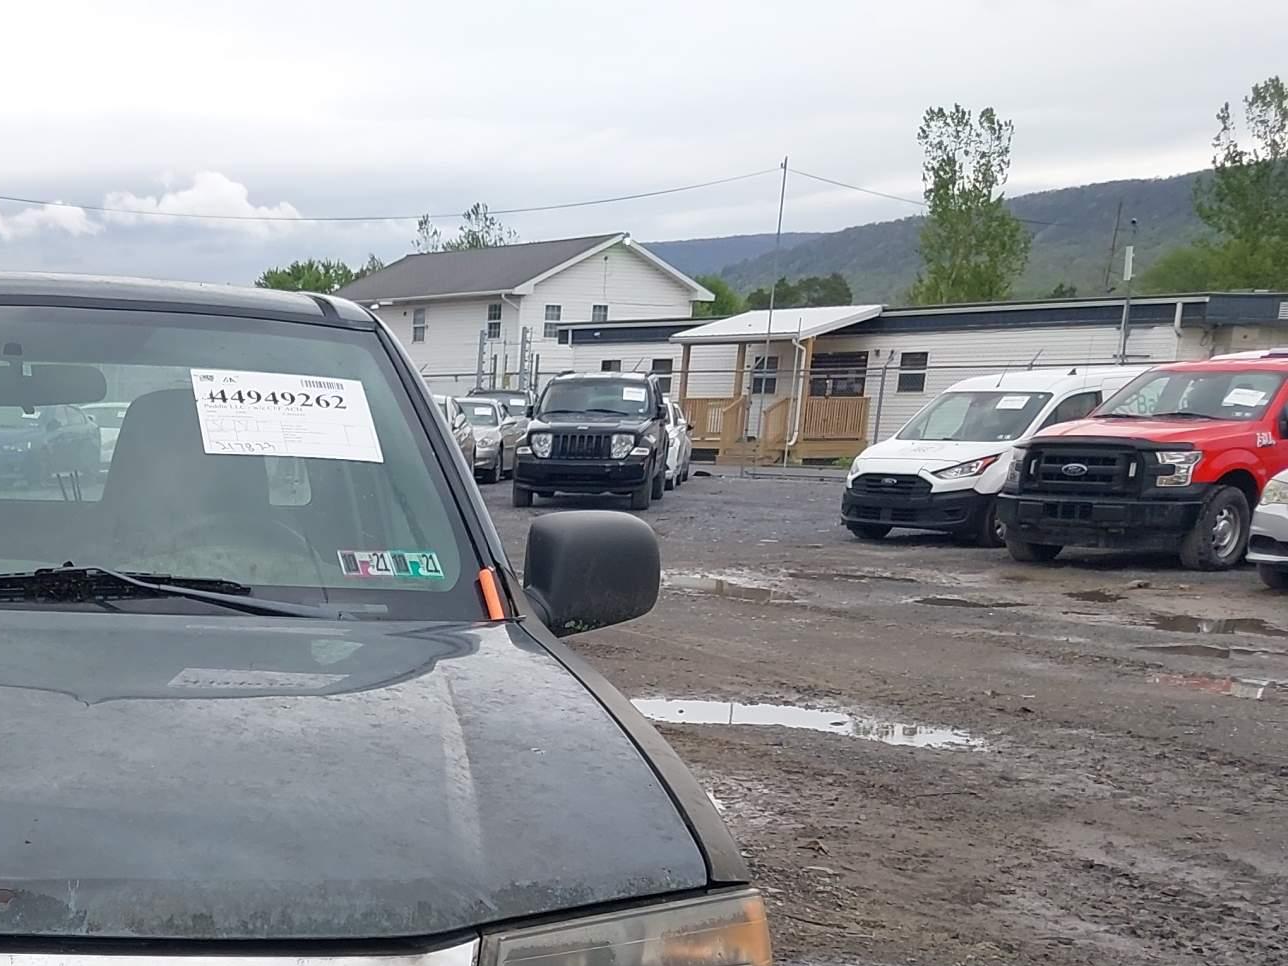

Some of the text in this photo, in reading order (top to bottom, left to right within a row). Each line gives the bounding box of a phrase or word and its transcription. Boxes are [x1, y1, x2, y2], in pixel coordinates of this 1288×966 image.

[203, 389, 347, 410] 44949262
[373, 553, 391, 571] 21
[422, 554, 441, 574] 21
